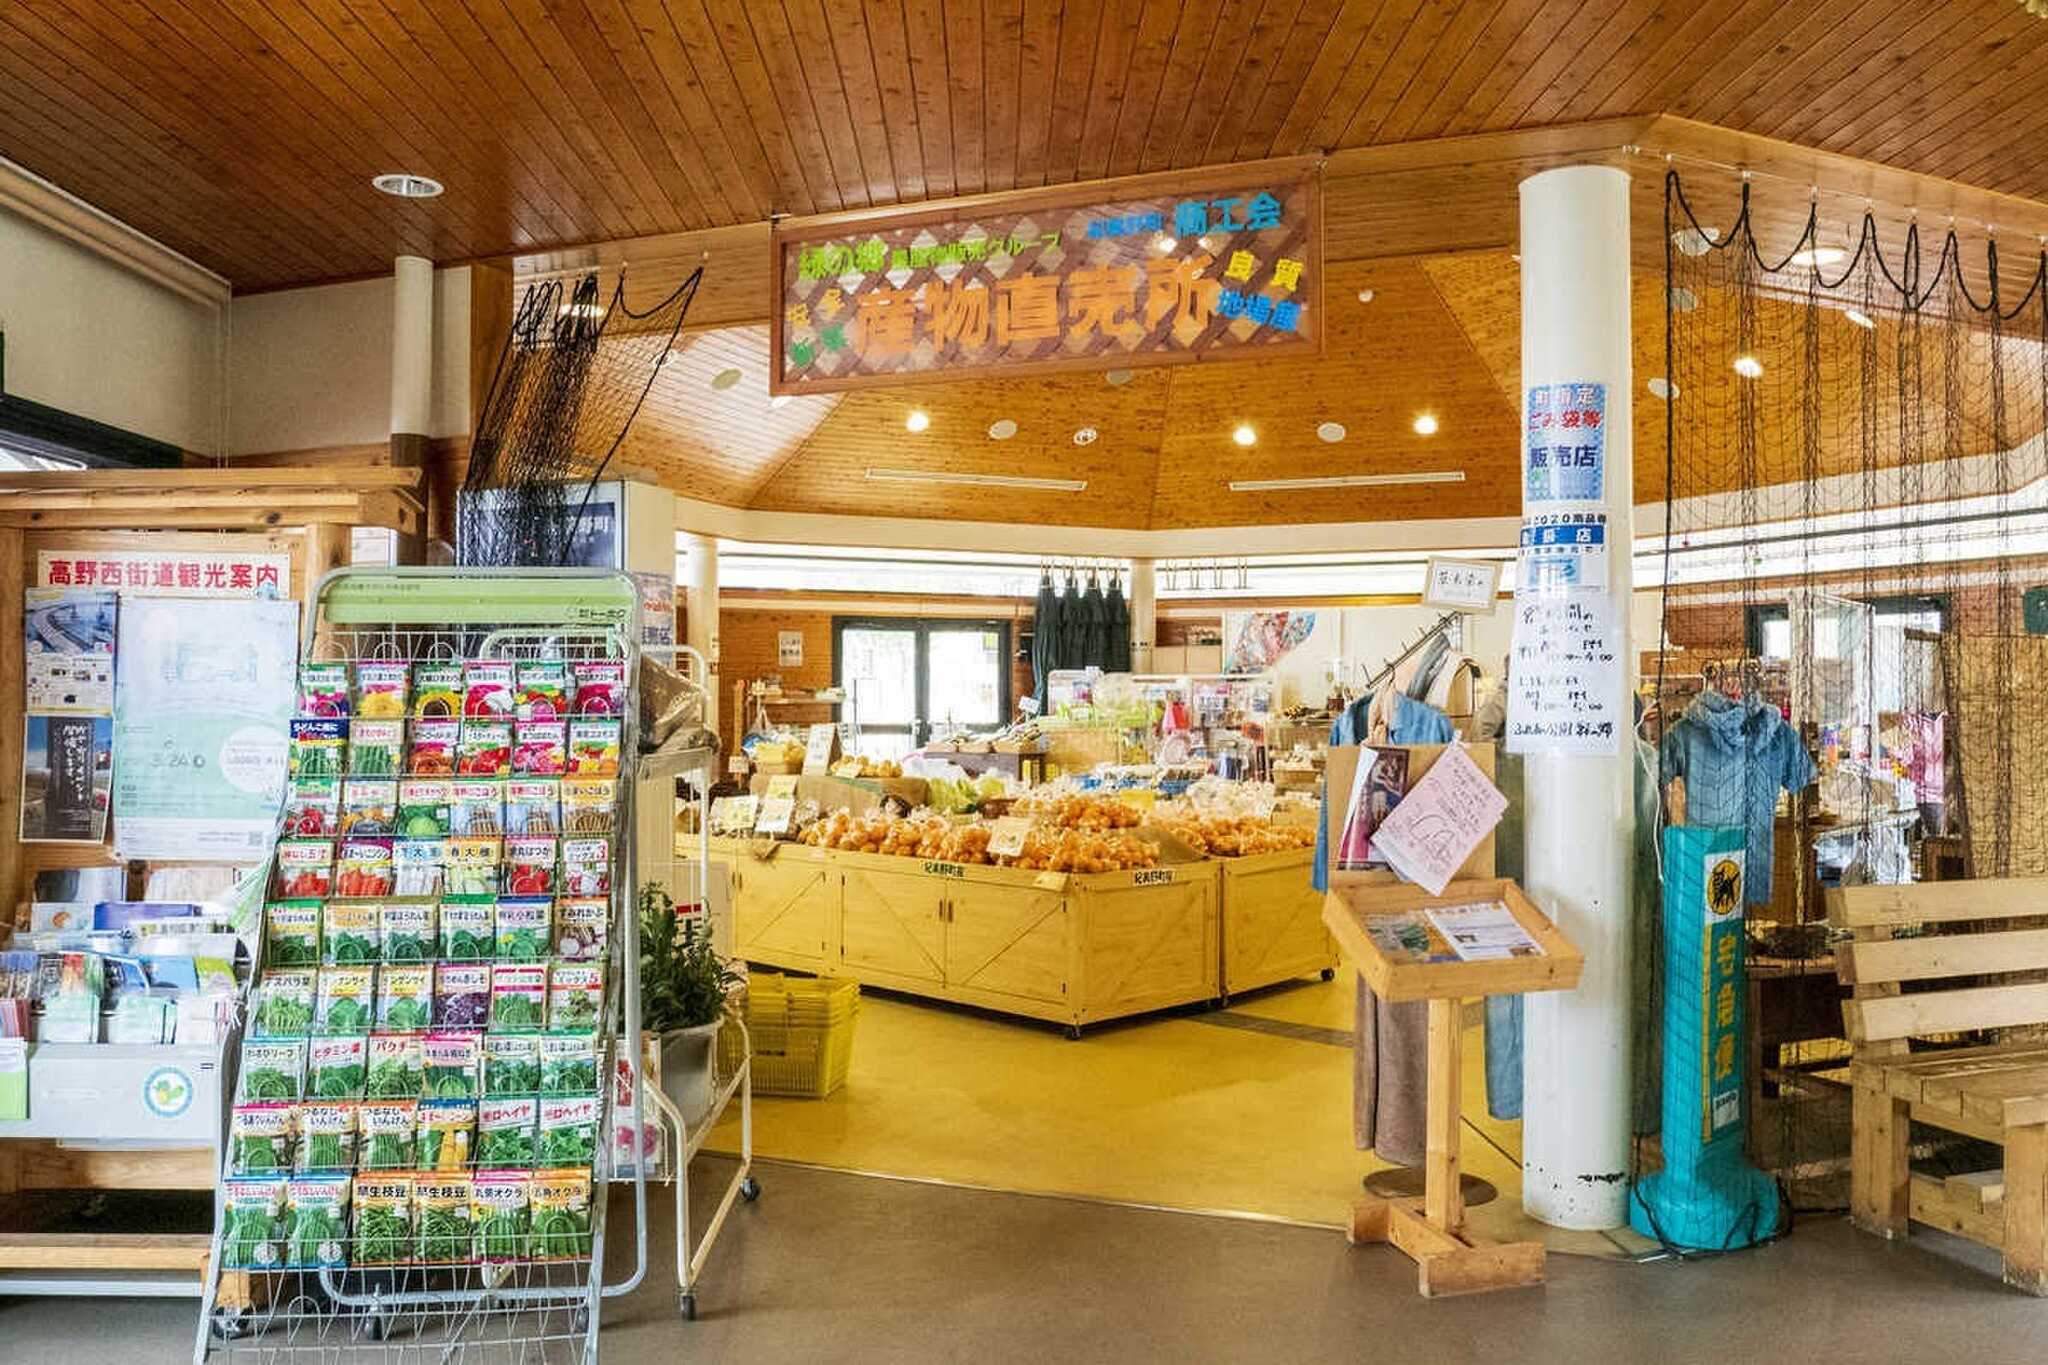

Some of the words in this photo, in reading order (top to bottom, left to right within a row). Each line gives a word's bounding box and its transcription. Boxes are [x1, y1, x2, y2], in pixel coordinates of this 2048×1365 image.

[857, 255, 1222, 354] 産物直売所
[1530, 444, 1597, 468] 販売店
[49, 559, 279, 590] 高野西街道観光案内
[483, 1104, 531, 1122] モロヘイヤ
[357, 1185, 407, 1199] 早生枝豆
[416, 1186, 467, 1199] 早生枝豆
